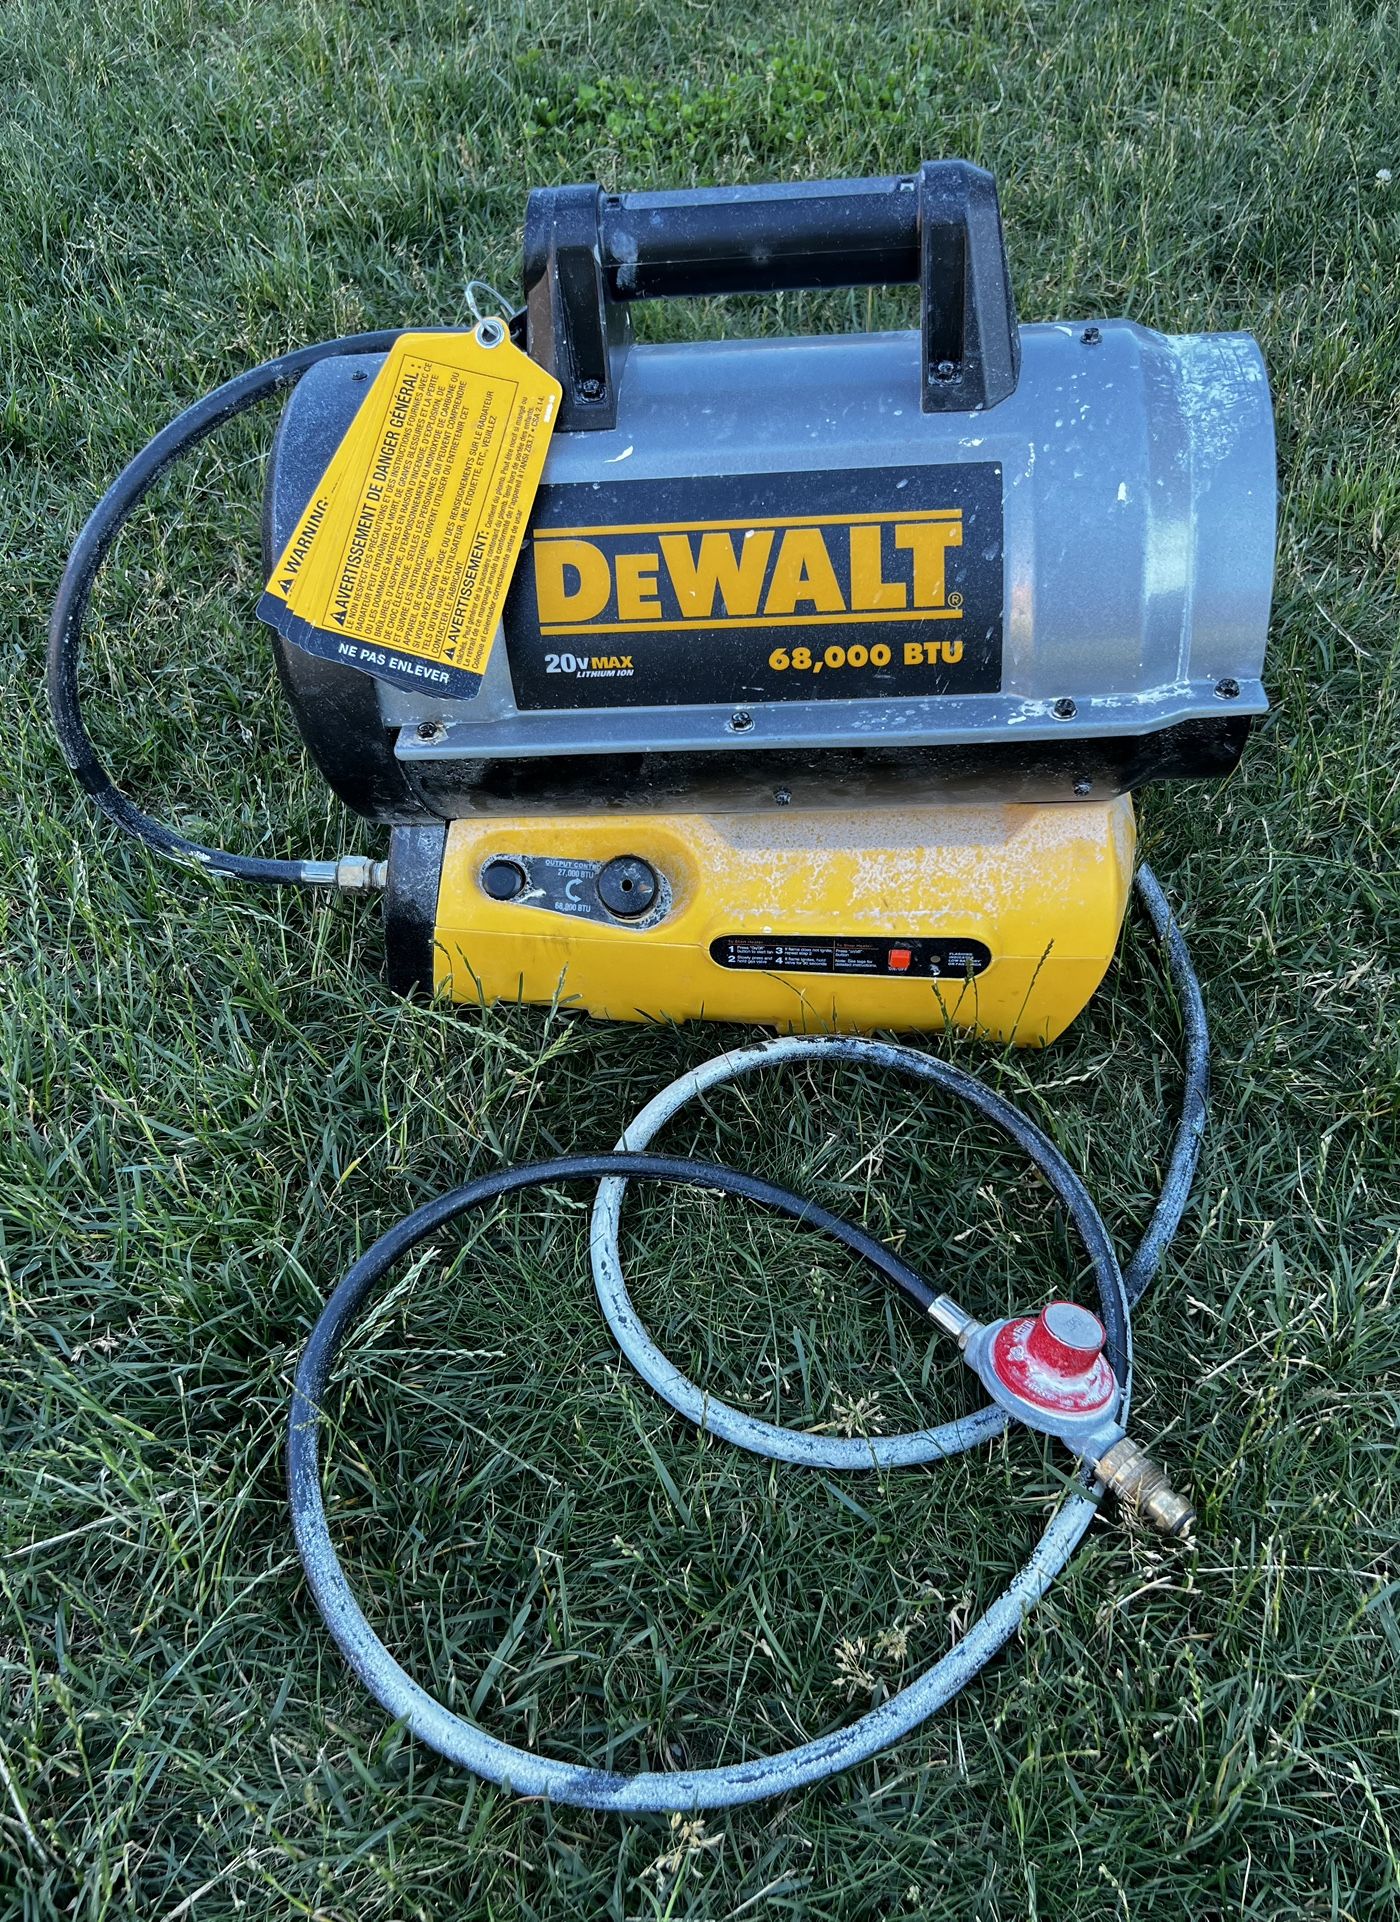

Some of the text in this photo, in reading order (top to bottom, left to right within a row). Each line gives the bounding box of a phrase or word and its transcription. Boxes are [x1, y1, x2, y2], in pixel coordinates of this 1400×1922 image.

[388, 370, 418, 428] GÉNÉRAL
[476, 390, 494, 429] RADIATEUR
[468, 440, 479, 455] SUR
[473, 430, 482, 439] LE
[372, 430, 400, 482] DANGER
[344, 362, 432, 629] LE NON RESPECT DES PRÉCAUTIONS ET DES INSTRUCTIONS FOURNIES AVEC CE
[354, 374, 438, 631] RADIATEUR PEUT ENTRAÎNER LA MORT, DE GRAVES BLESSURES ET LA PERTE
[366, 483, 384, 501] DE
[373, 371, 459, 637] BRÛLURES, D'ASPHYXIE, D'EMPOISONNEMENT AU MONOXYDE DE CARBONE OU
[449, 456, 474, 520] RENSEIGNEMENTS
[364, 385, 445, 634] OU LES DOMMAGES MATÉRIELS EN RAISON D'INCENDIE, D'EXPLOSION, DE
[383, 380, 467, 639] DE CHOC ÉLECTRIQUE. SEULES LES PERSONNES QUI PEUVENT COMPRENDRE
[392, 405, 469, 642] ET SUIVRE LES INSTRUCTIONS DOIVENT UTILISER OU ENTRETENIR CET
[444, 521, 455, 536] DES
[421, 414, 497, 650] TELS QU'UN GUIDE DE L'UTILISATEUR, UNE ÉTIQUETTE, ETC., VEUILLEZ
[441, 536, 451, 547] OU
[334, 503, 377, 609] AVERTISSEMENT
[434, 548, 447, 572] D'AIDE
[402, 555, 435, 645] APPAREIL DE CHAUFFAGE.
[426, 573, 440, 600] BESOIN
[446, 529, 489, 643] AVERTISSEMENT:
[420, 601, 432, 619] AVEZ
[431, 560, 464, 653] CONTACTER LE FABRICANT.
[414, 620, 426, 640] VOUS
[338, 643, 450, 684] NE PAS ENLEVER
[576, 670, 615, 678] LITHIUM
[591, 656, 634, 670] MAX
[768, 640, 963, 674] 68,000 BTU
[546, 860, 572, 868] OUTPUT
[558, 868, 594, 879] 27,000 BTU
[578, 904, 591, 912] BTU
